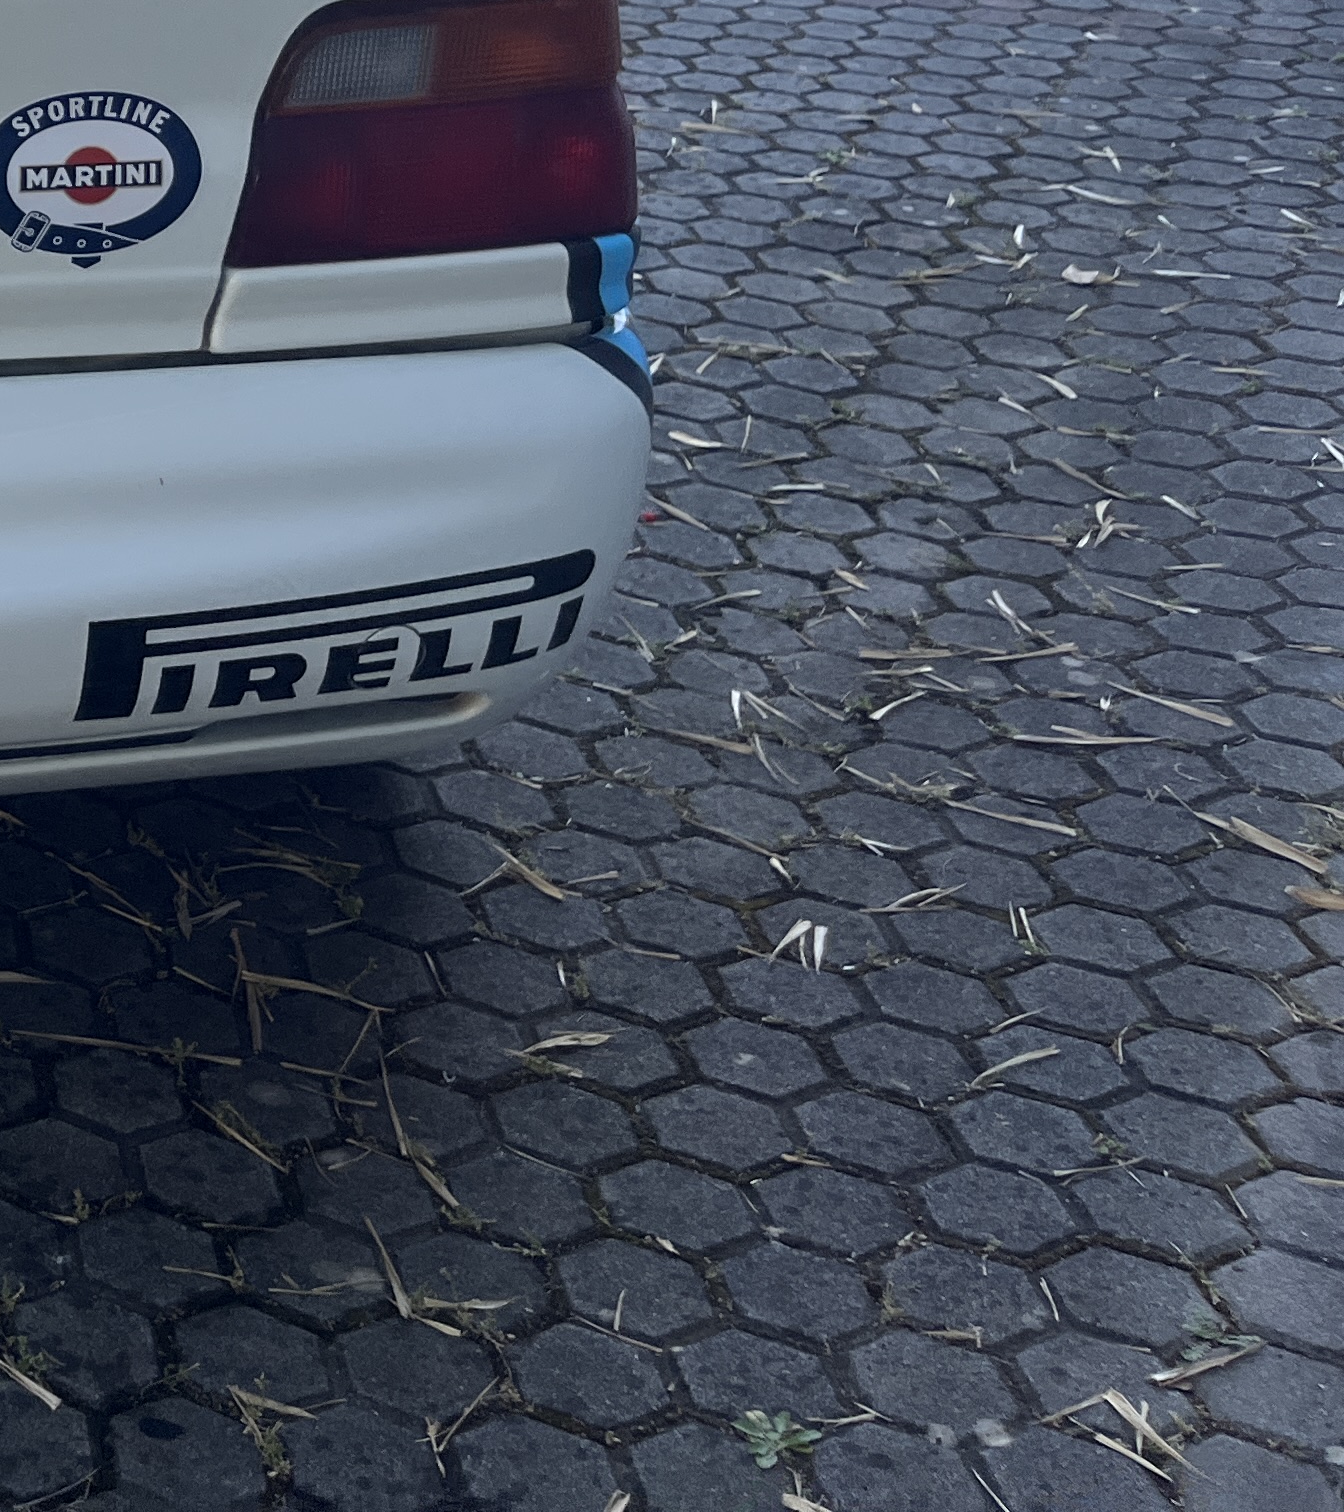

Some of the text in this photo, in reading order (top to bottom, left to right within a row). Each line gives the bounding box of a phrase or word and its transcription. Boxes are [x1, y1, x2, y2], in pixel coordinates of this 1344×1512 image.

[11, 95, 171, 138] SPORTLINE
[25, 163, 158, 189] MARTINI
[73, 548, 597, 722] PIRELLI
